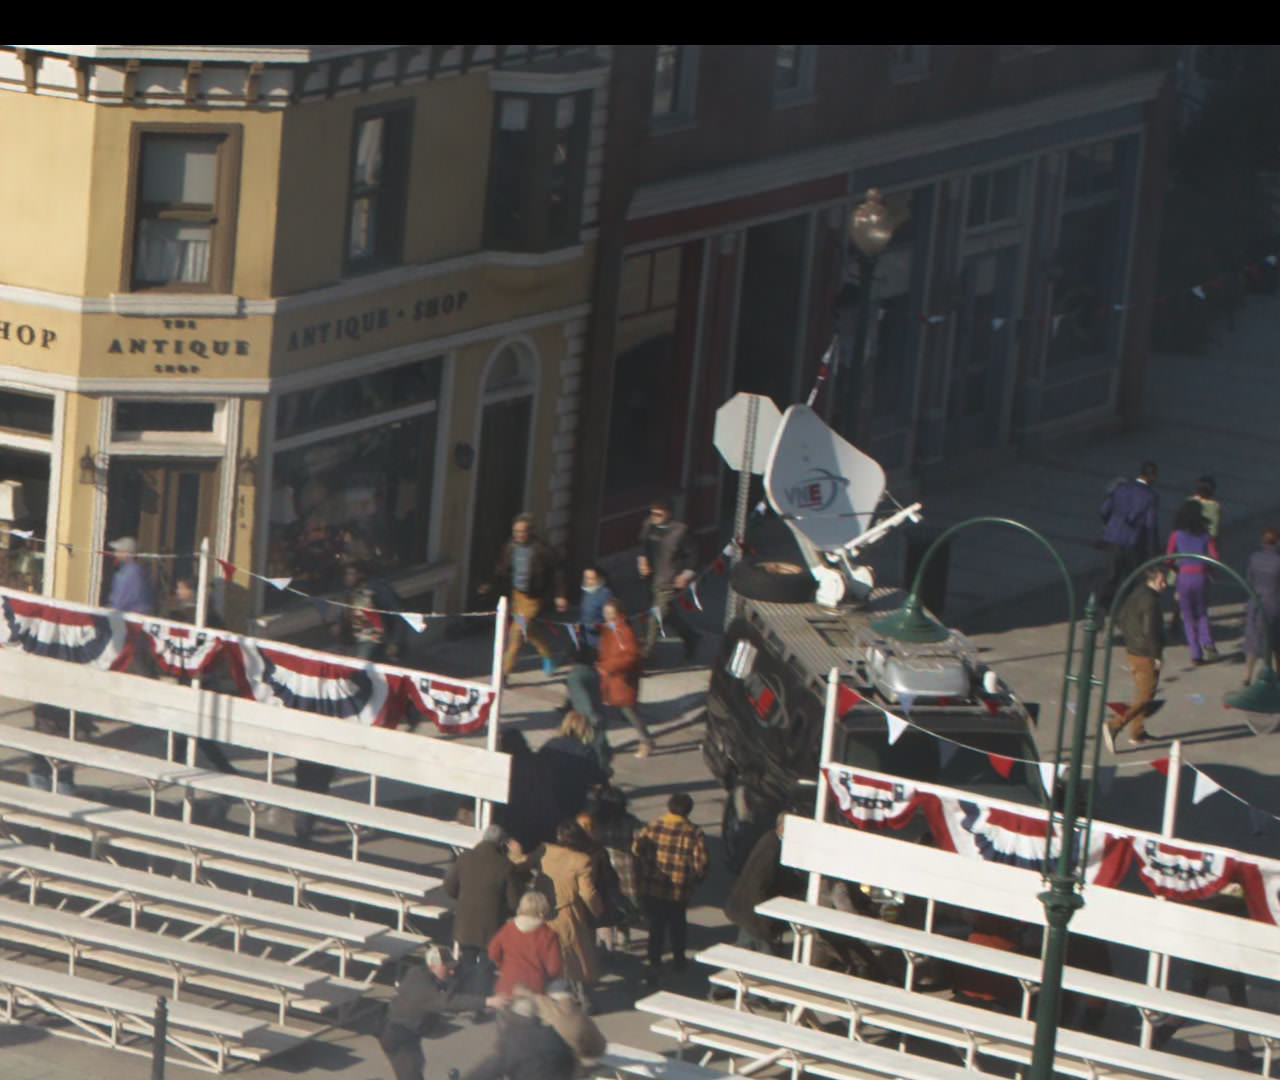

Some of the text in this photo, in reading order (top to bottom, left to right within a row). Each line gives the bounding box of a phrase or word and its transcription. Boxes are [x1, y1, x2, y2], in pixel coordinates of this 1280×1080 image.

[162, 318, 197, 330] THE
[287, 289, 469, 352] ANTIQUE SHOP
[107, 338, 250, 359] ANTIQUE
